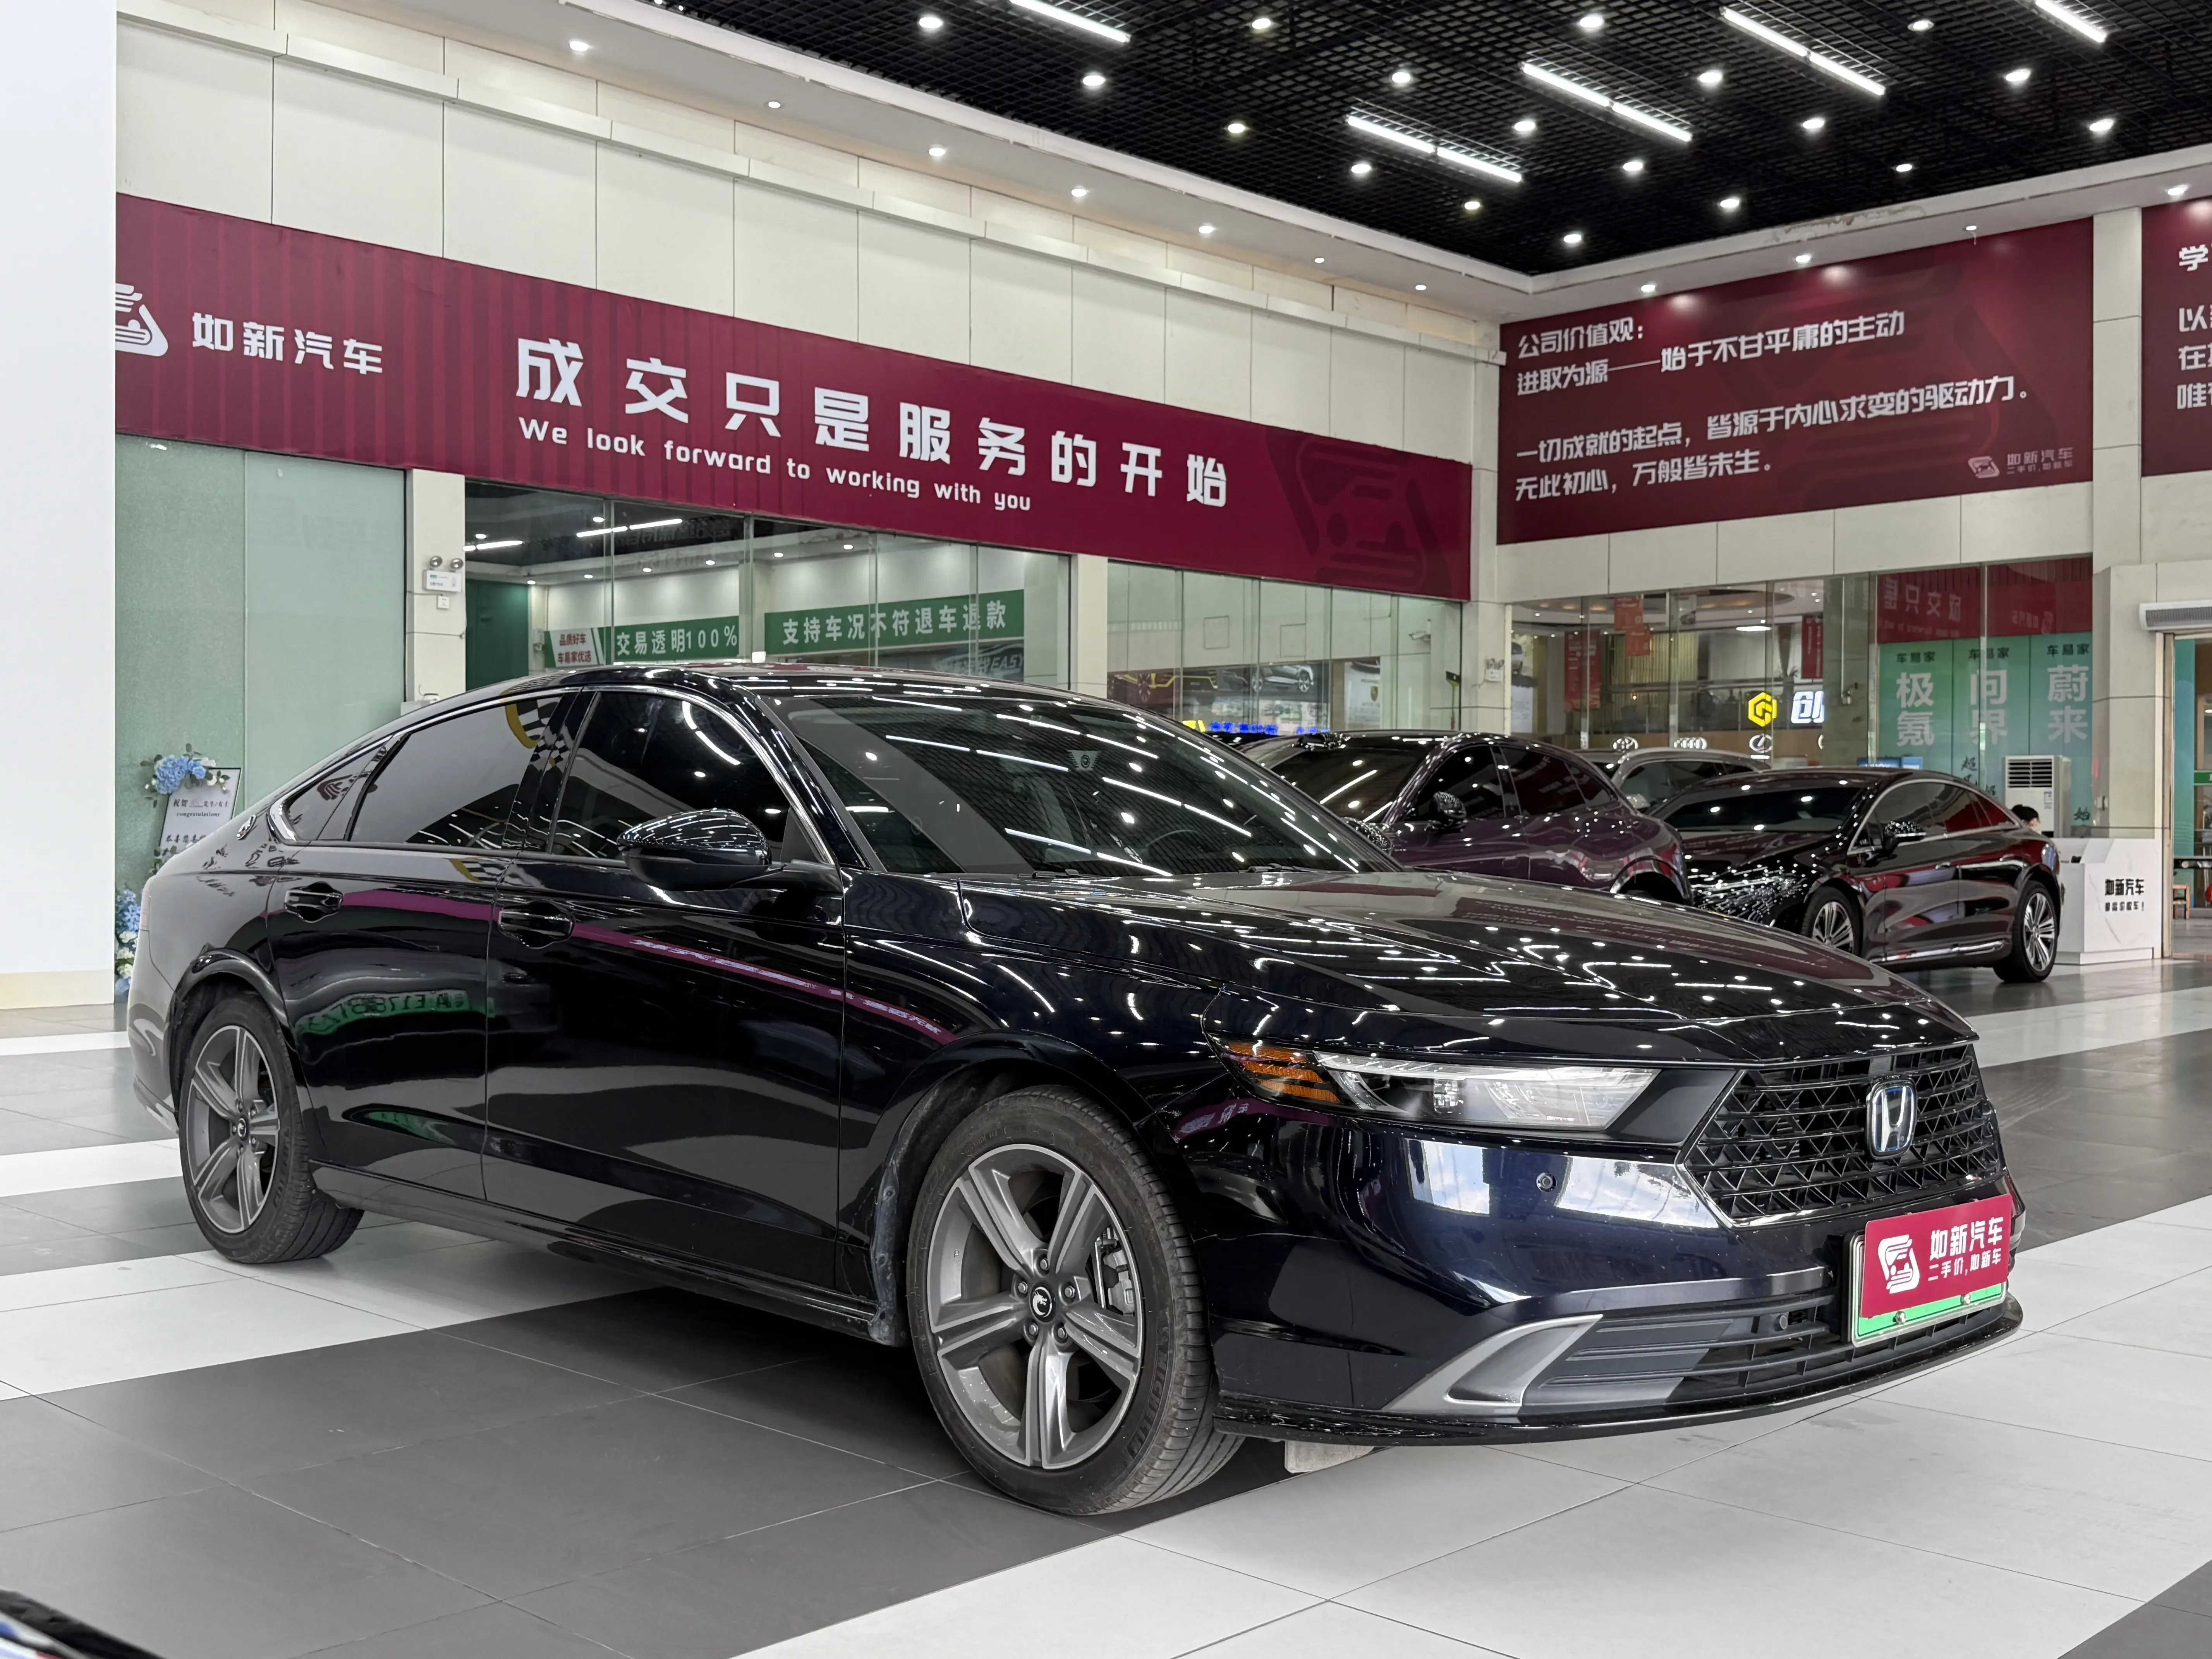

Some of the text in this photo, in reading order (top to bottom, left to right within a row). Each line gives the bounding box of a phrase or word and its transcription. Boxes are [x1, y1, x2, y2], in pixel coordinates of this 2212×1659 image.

[2179, 244, 2212, 271] 学
[1518, 316, 1644, 359] 公司价值观：
[2179, 304, 2212, 332] 以
[192, 312, 383, 374] 如新汽车
[516, 338, 1226, 507] 成交只是服务的开始
[519, 417, 1030, 511] We look forward to working with you
[617, 625, 738, 656] 交易透明100%
[783, 600, 1006, 646] 支持车况不符退车退款
[1896, 672, 1935, 746] 极氪
[2047, 664, 2089, 743] 蔚来
[1929, 1216, 2003, 1261] 如新汽车
